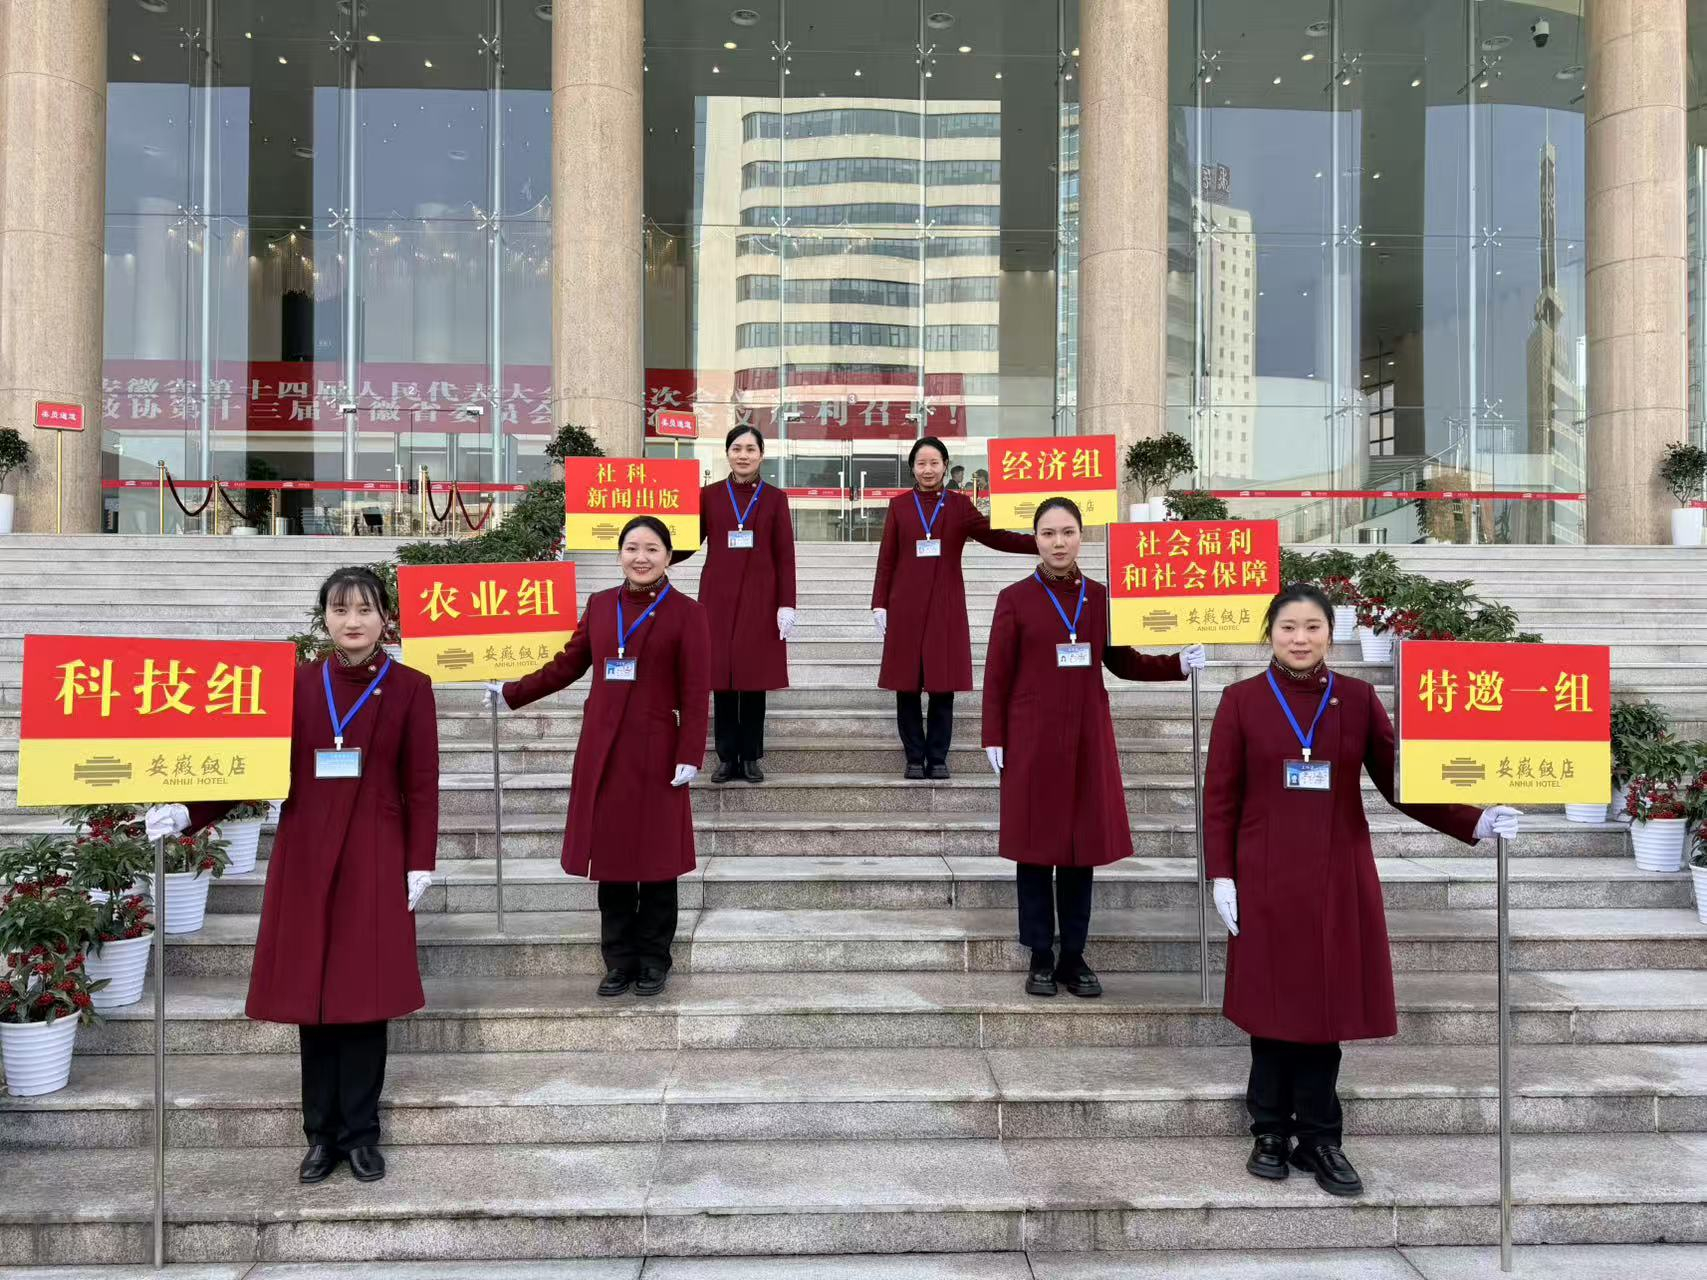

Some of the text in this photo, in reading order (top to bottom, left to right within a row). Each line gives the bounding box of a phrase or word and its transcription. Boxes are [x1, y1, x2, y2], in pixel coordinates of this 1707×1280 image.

[1002, 448, 1103, 481] 经济组
[587, 487, 680, 509] 新闻出版
[1136, 528, 1251, 558] 社会福利
[1121, 560, 1268, 591] 和社会保障
[418, 578, 560, 622] 农业组
[54, 658, 268, 717] 科技组
[1418, 668, 1594, 713] 特邀一组
[162, 777, 229, 786] ANHUI HOTEL
[1509, 780, 1561, 788] ANHUI HOTEL
